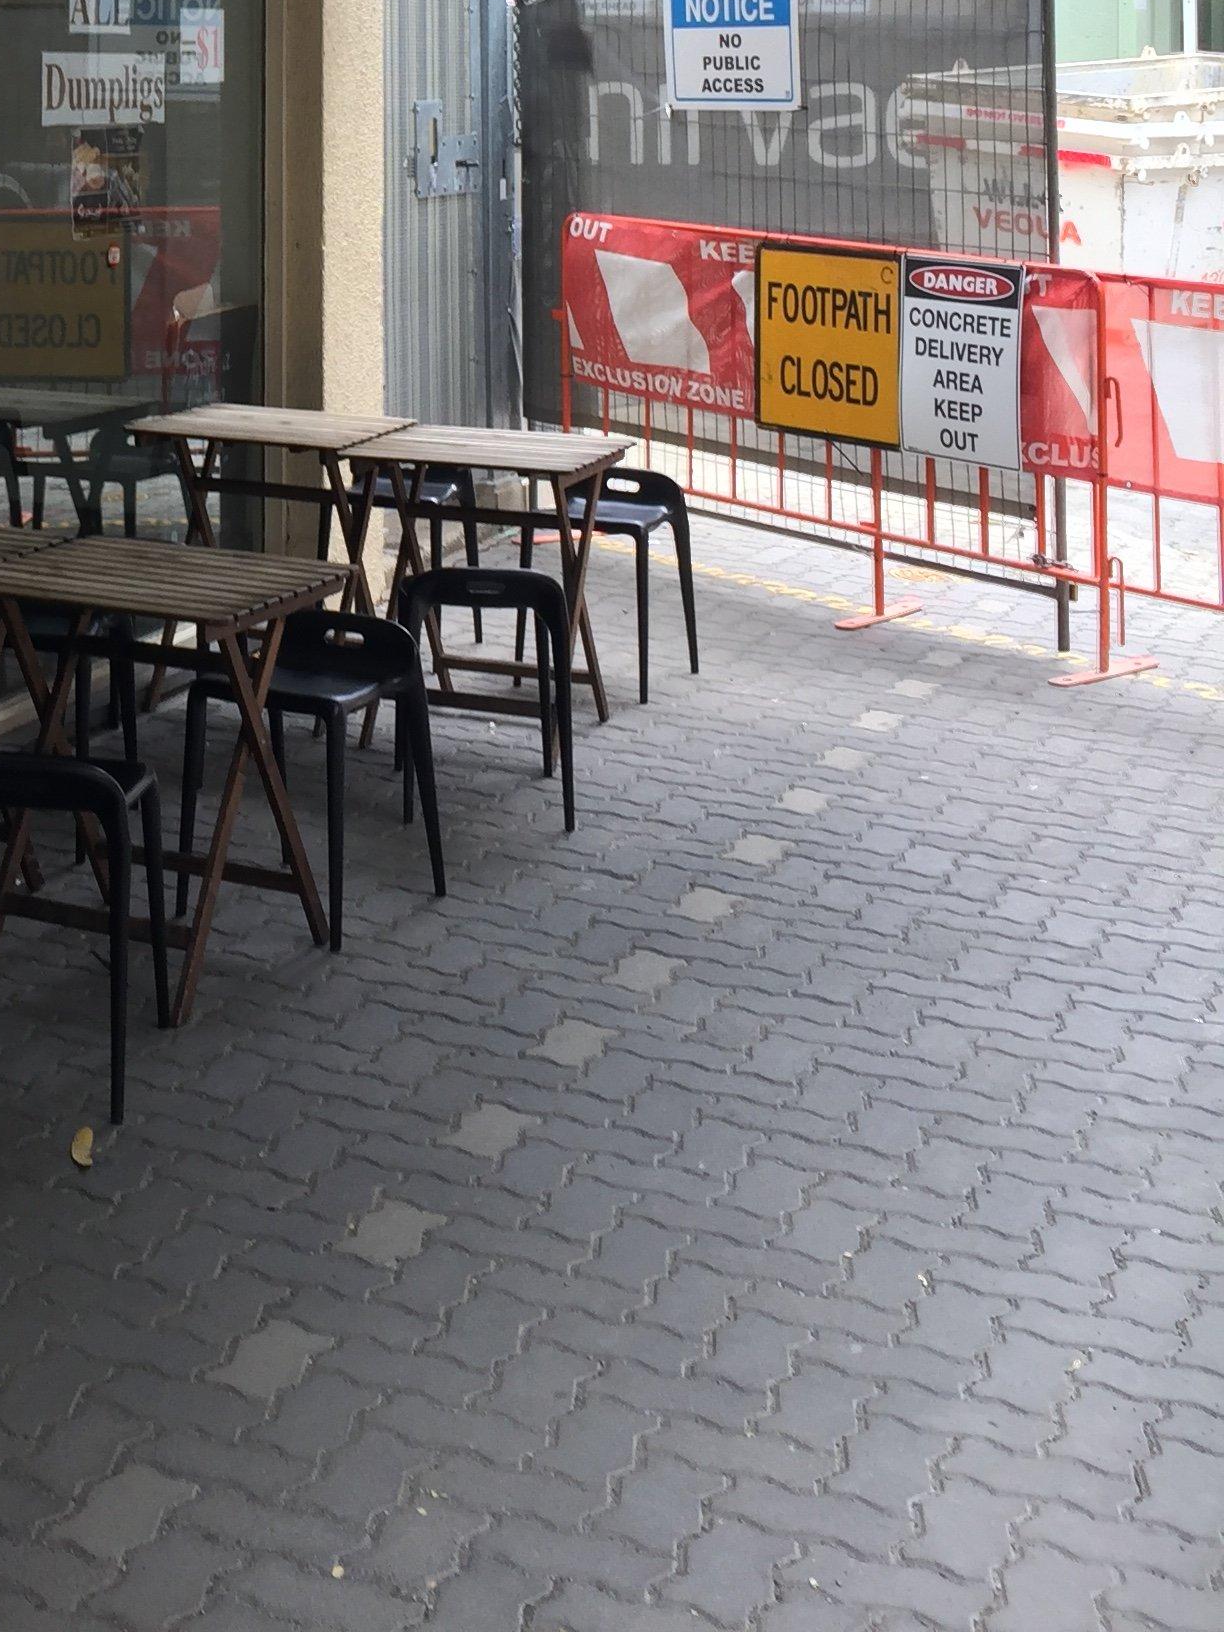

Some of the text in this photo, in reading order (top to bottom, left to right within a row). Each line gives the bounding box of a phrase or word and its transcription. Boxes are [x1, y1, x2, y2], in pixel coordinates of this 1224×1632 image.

[719, 33, 742, 49] NO
[702, 56, 761, 71] PUBLIC
[45, 63, 165, 124] Dumpligs
[702, 78, 765, 94] ACCESS
[569, 216, 613, 243] OUT
[699, 239, 755, 264] KEE
[923, 271, 998, 296] DANGER
[767, 280, 892, 335] FOOTPATH
[909, 306, 1012, 339] CONCRETE
[914, 336, 1004, 367] DELIVERY
[572, 354, 746, 411] EXCLUSION ZONE
[780, 354, 878, 407] CLOSED
[932, 369, 984, 395] AREA
[934, 398, 983, 424] KEEP
[939, 428, 979, 453] OUT
